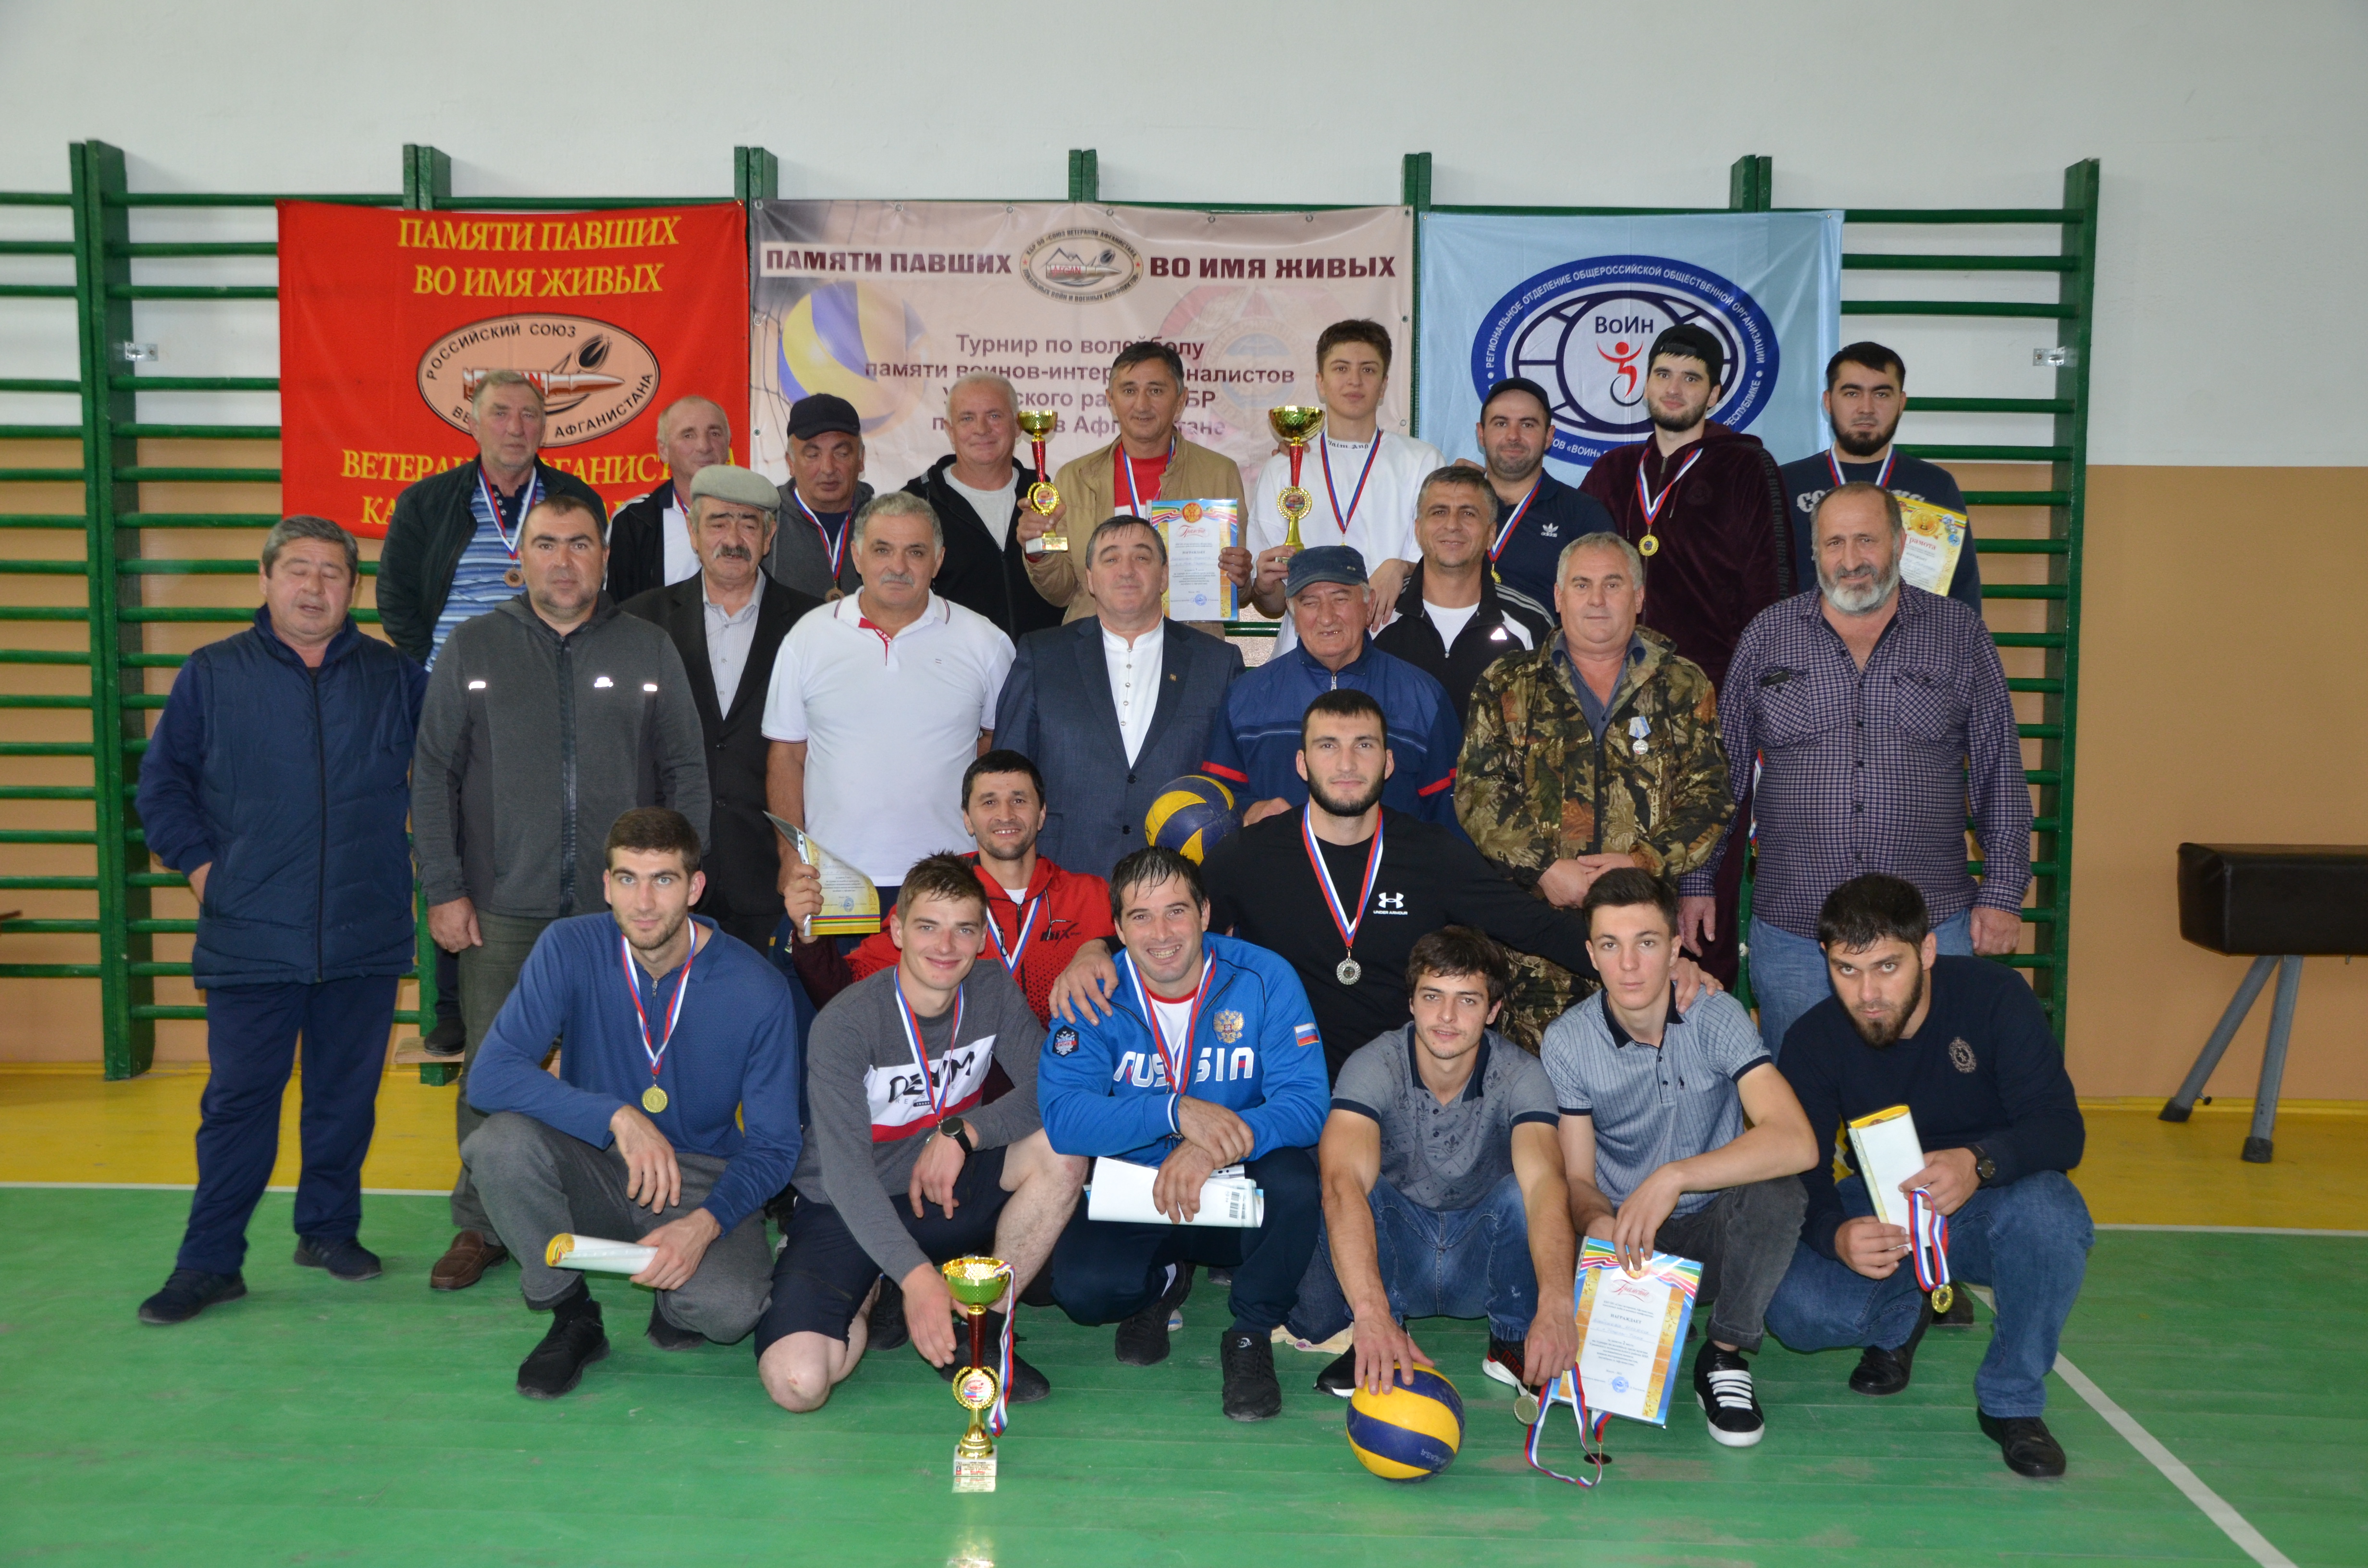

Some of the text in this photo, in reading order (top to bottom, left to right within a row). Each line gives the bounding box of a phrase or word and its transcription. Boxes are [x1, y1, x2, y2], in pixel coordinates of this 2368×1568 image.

[398, 216, 682, 250] ПАМЯТИ ПАВШИХ
[1067, 229, 1099, 237] ВЕТЕРАНОВ
[766, 250, 1012, 274] ПАМЯТИ ПАВШИХ
[1149, 255, 1396, 279] ВО ИМЯ ЖИВЫХ
[413, 263, 665, 297] ВО ИМЯ ЖИВЫХ
[1074, 294, 1103, 303] ВОЕННЫХ
[1486, 263, 1765, 368] РЕГИОНАЛЬНОЕ ОТДЕЛЕНИЕ ОБЩЕРОССИЙСКОЙ ОБЩЕСТВЕННОЙ ОРГАНИЗАЦИИ
[1594, 315, 1653, 334] ВоИн
[426, 322, 521, 380] РОССИЙСКИЙ
[530, 323, 576, 338] СОЮЗ
[956, 334, 1205, 360] Турнир по волеболу
[865, 362, 1295, 384] памяти воинов-интерналистов
[554, 373, 654, 438] АФГАНИСТАНА
[1723, 380, 1761, 426] РЕСПУБЛИКЕ
[1073, 416, 1226, 437] Афгтане
[1566, 444, 1601, 458] «ВОИН»
[341, 449, 474, 482] ВЕТЕРА
[1909, 537, 1936, 550] рамота
